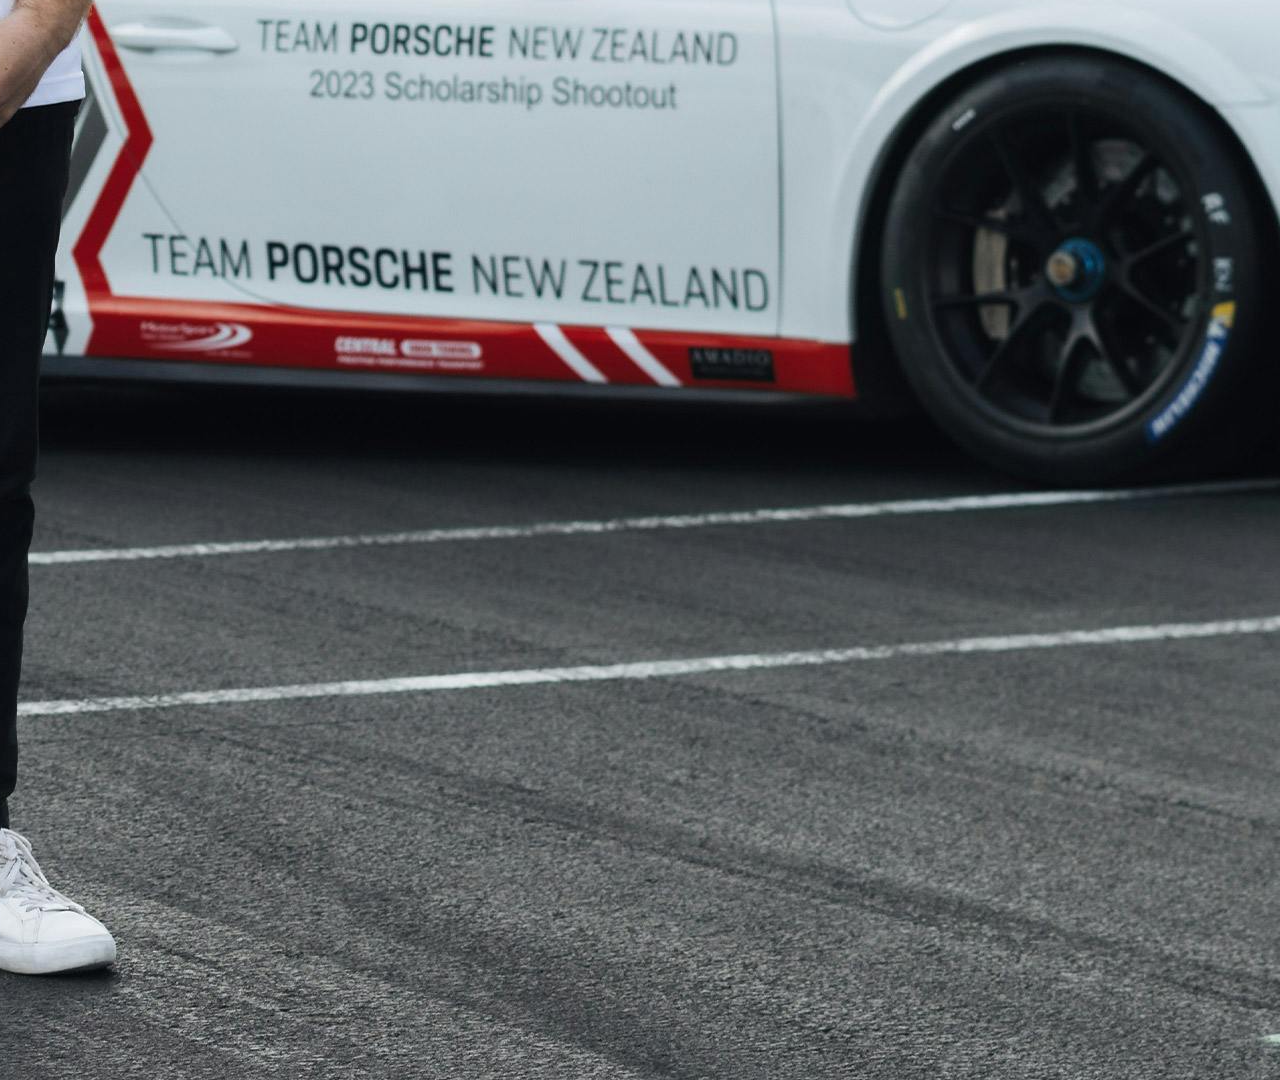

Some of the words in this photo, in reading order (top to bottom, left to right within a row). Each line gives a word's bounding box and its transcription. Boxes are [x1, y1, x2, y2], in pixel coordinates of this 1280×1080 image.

[258, 19, 339, 54] TEAM
[350, 23, 495, 58] PORSCHE
[509, 26, 584, 61] NEW
[591, 28, 739, 66] ZEALAND
[310, 69, 376, 99] 2023
[384, 71, 542, 110] Scholarship
[552, 76, 677, 109] Shootout
[142, 234, 252, 279] TEAM
[266, 241, 455, 293] PORSCHE
[473, 255, 568, 299] NEW
[578, 260, 771, 312] ZEALAND
